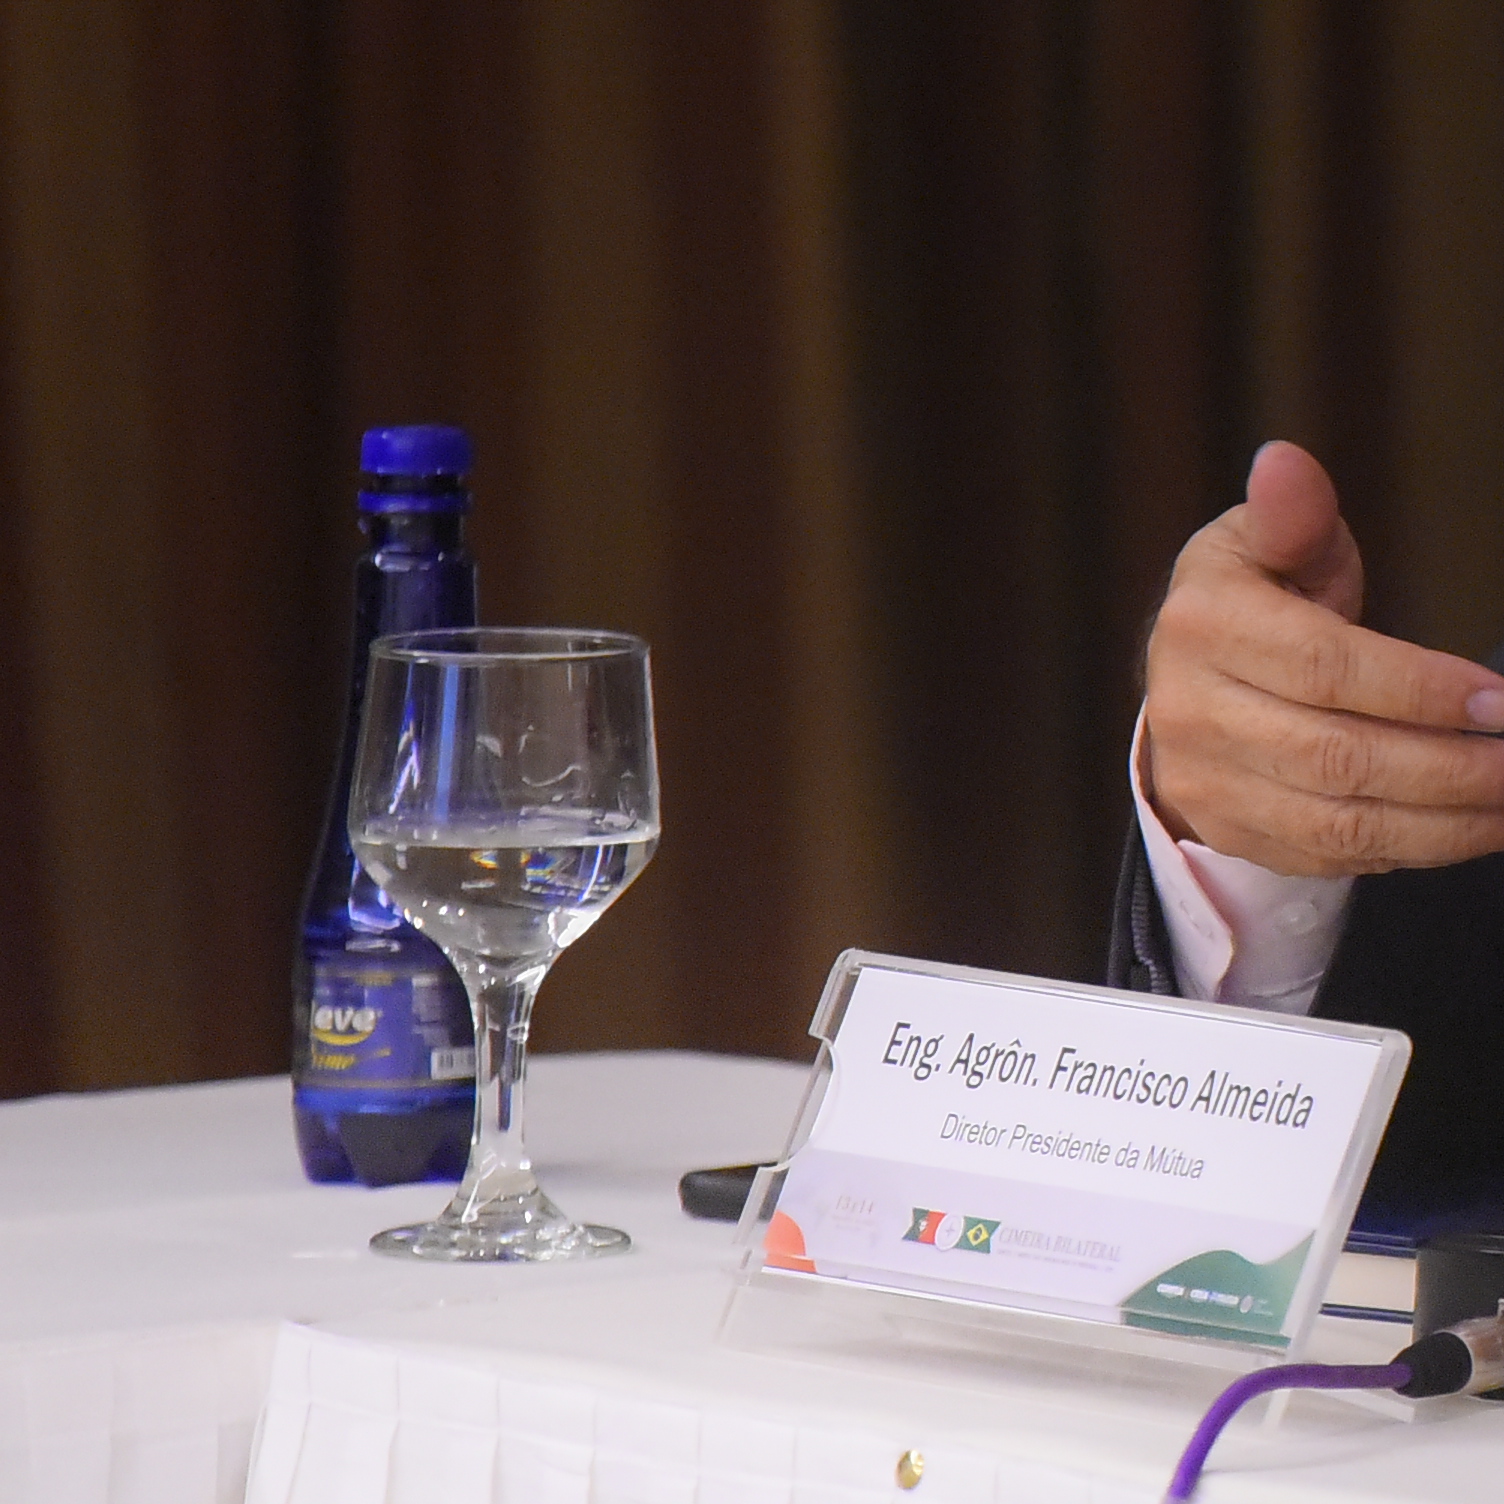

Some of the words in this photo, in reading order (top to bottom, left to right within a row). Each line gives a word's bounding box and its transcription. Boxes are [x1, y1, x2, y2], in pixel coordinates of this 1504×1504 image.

[882, 1021, 944, 1081] Eng.
[947, 1032, 1038, 1089] Agrôn.
[1048, 1047, 1189, 1109] Francisco
[1190, 1069, 1314, 1129] Almeida
[940, 1113, 1007, 1147] Diretor
[1008, 1124, 1111, 1164] Presidente
[1114, 1141, 1140, 1169] da
[1143, 1144, 1205, 1180] Mútua
[998, 1226, 1051, 1251] CIMEIRA
[1052, 1235, 1121, 1263] BILATERAL
